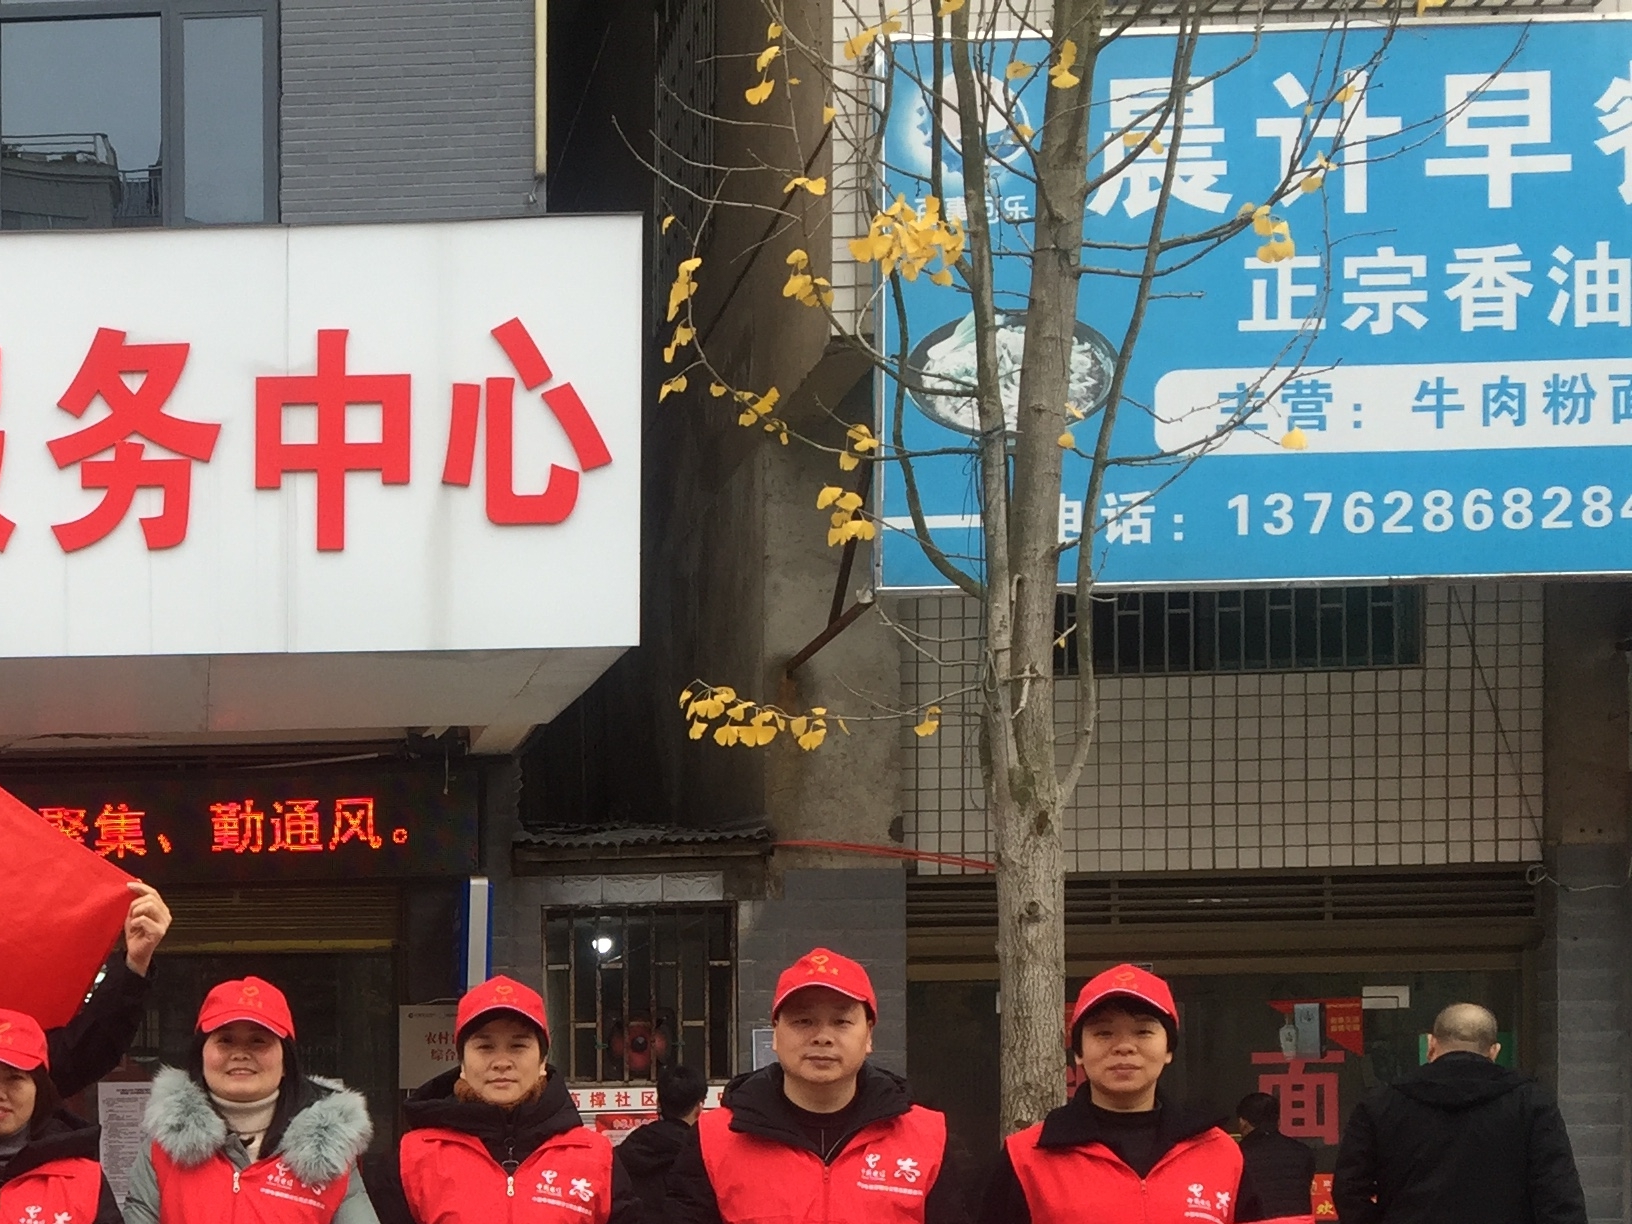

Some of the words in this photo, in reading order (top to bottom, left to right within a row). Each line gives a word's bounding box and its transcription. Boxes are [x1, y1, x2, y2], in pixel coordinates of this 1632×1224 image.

[1086, 70, 1632, 218] 晨计早
[1238, 241, 1632, 334] 正宗香油
[1252, 1050, 1345, 1145] 面
